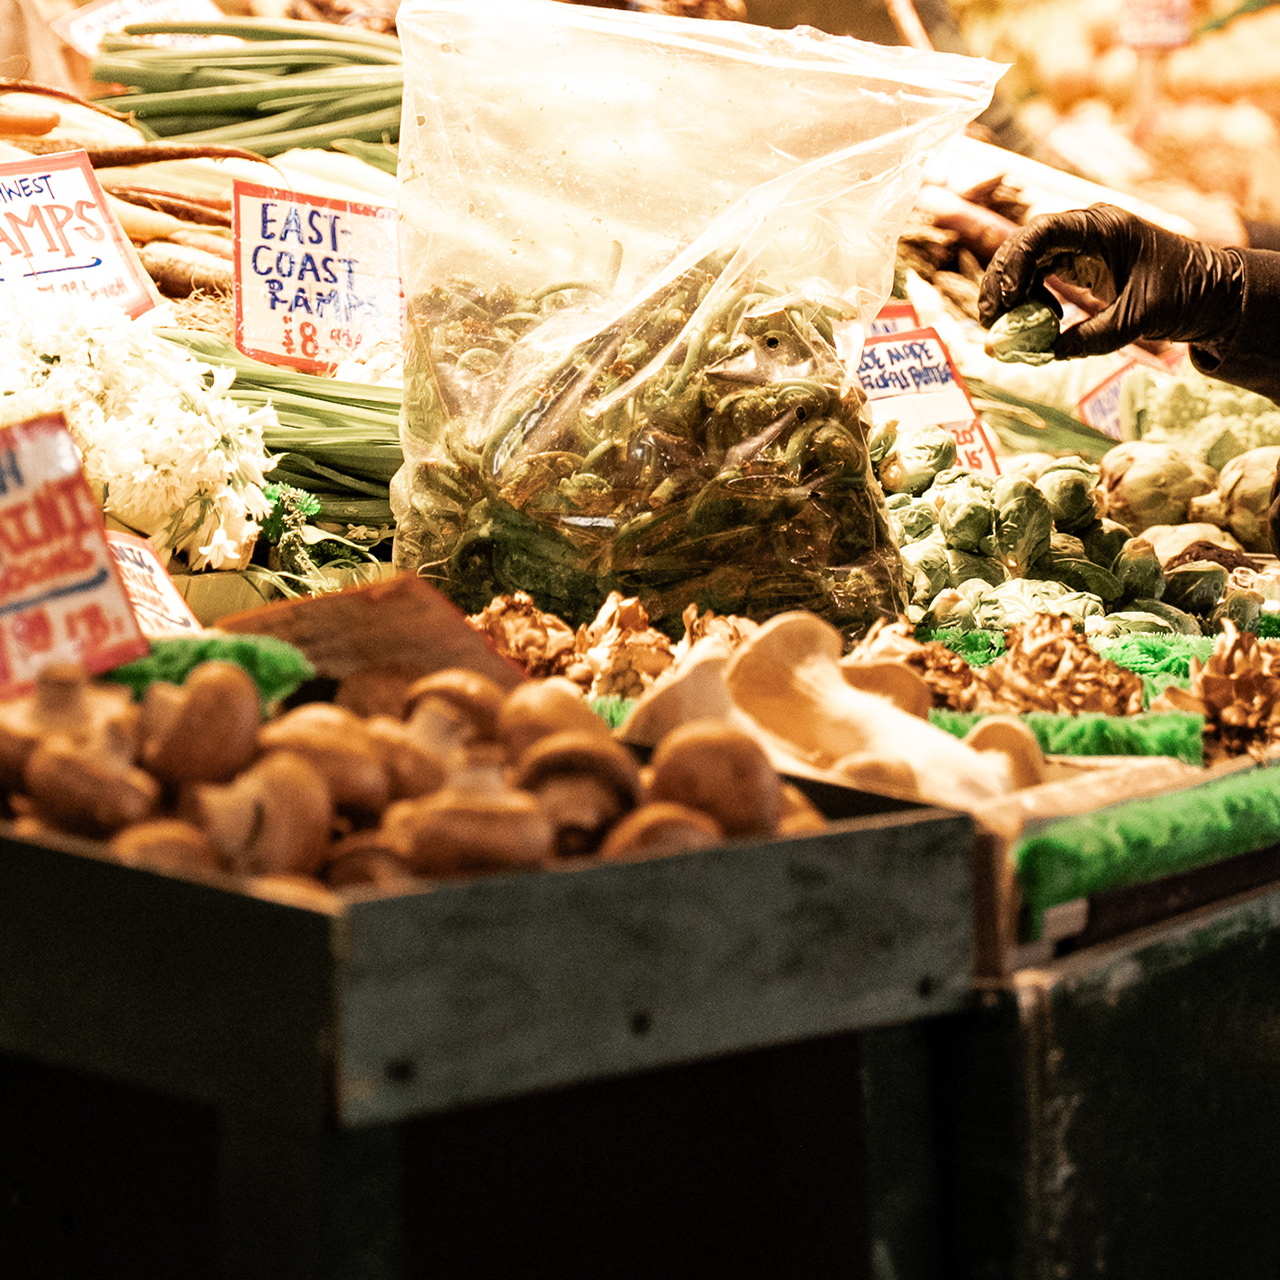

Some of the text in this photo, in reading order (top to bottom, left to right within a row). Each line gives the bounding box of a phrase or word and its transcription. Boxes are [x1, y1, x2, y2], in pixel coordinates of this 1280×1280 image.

[261, 202, 341, 252] EAST
[251, 245, 360, 291] COAST
[264, 278, 383, 322] RAMPS
[886, 341, 934, 368] MADE
